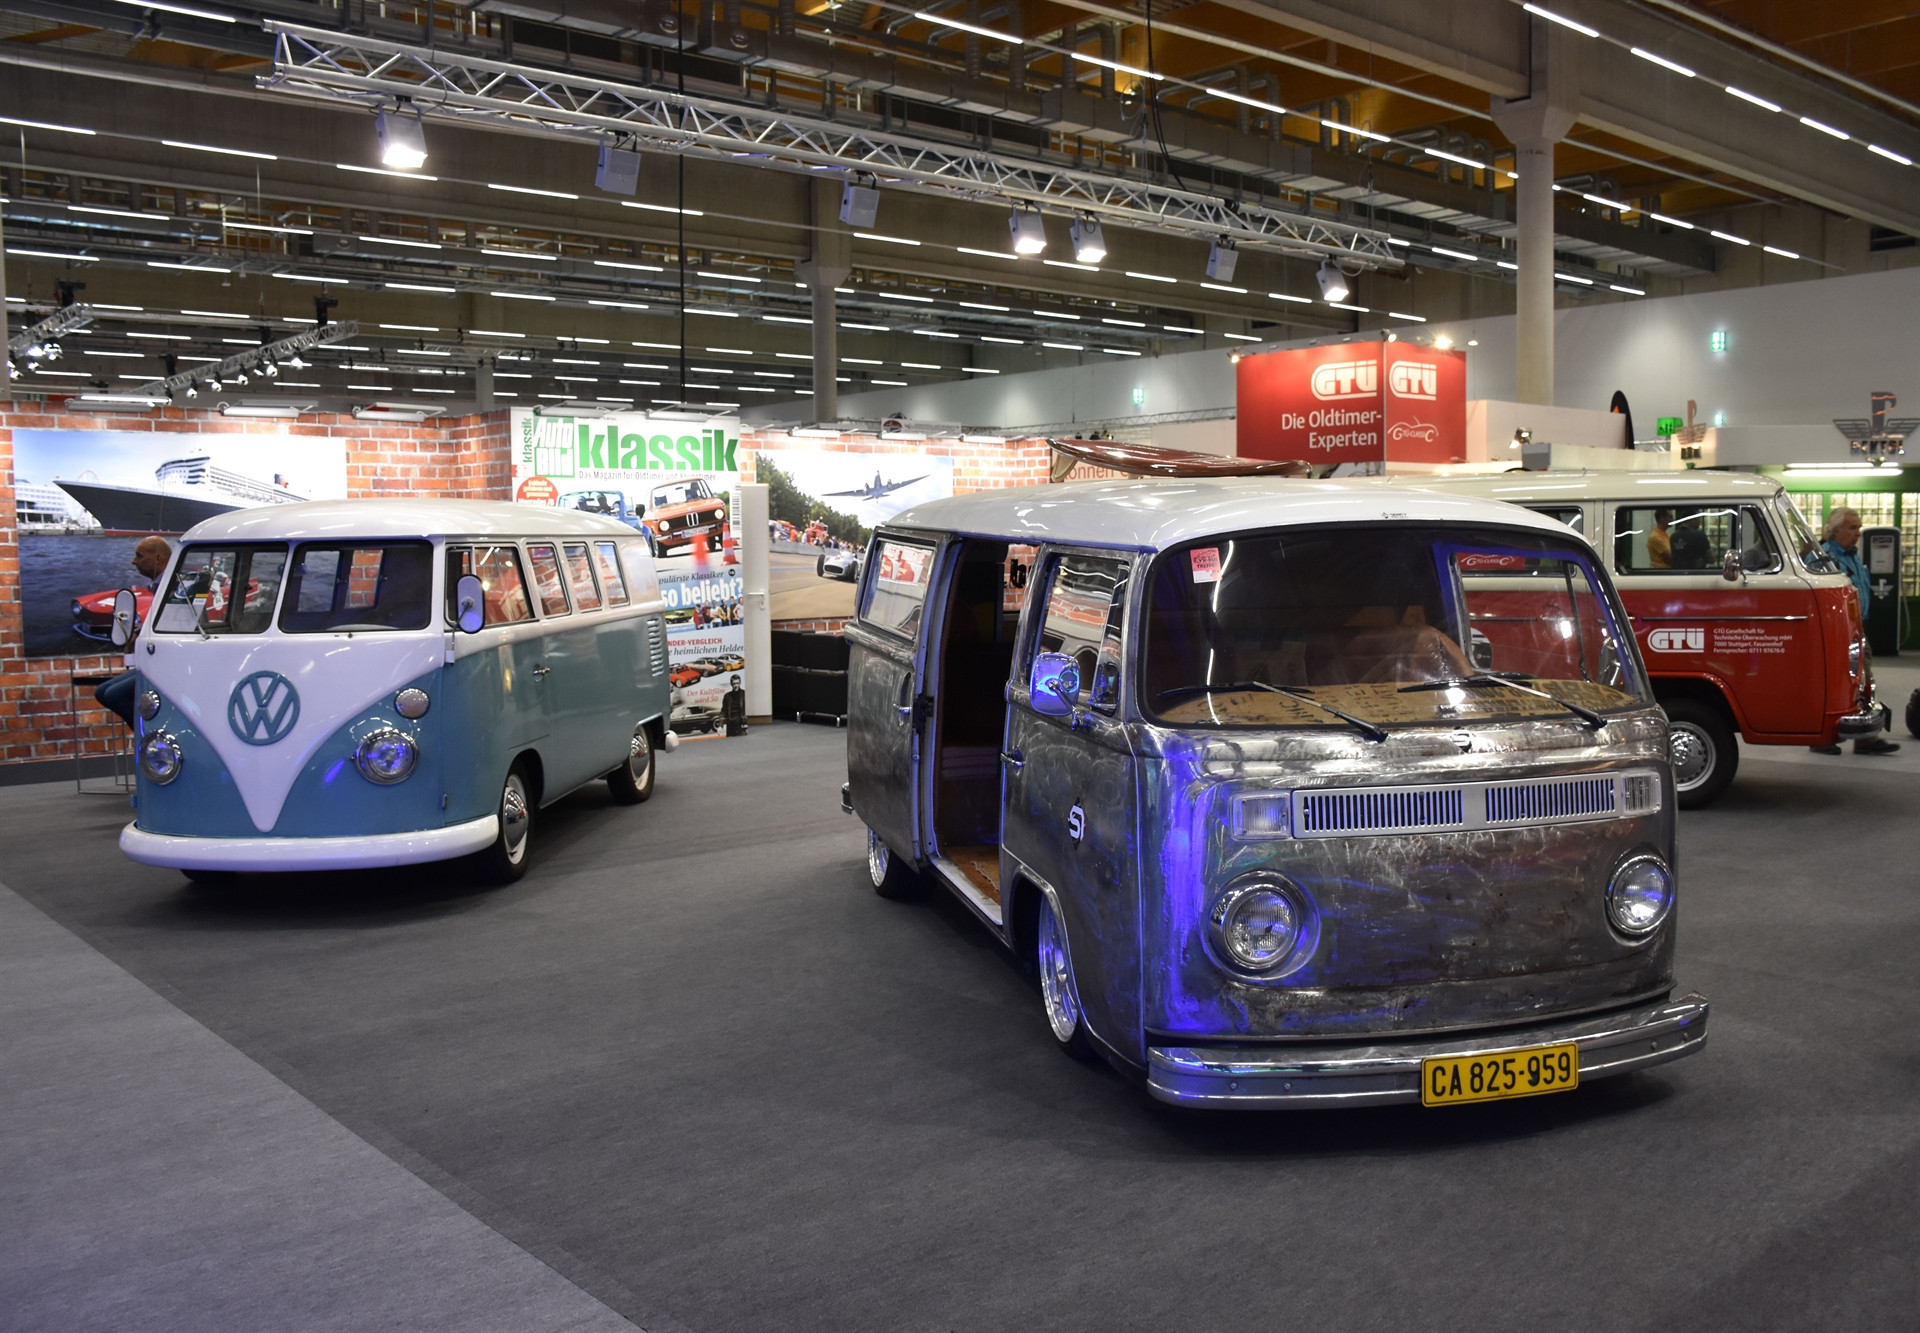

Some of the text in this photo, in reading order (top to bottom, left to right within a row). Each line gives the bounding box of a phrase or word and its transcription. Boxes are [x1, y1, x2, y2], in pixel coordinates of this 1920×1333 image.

[1311, 360, 1377, 401] GTÜ
[1389, 360, 1437, 401] GTÜ
[534, 417, 574, 448] Auto
[1282, 408, 1382, 430] Die Oldtimer-
[522, 418, 533, 463] klassik
[578, 424, 738, 472] klassik
[1309, 431, 1377, 452] Experten
[579, 471, 591, 479] Das
[594, 471, 622, 481] Magazin
[635, 472, 664, 480] Oldtimer
[1065, 465, 1115, 480] onnen
[691, 570, 725, 580] Klassiker
[681, 577, 743, 606] beliebt?
[674, 646, 717, 655] heimlichen
[1647, 628, 1704, 653] GTÜ
[228, 670, 300, 746] VW
[1432, 1052, 1570, 1097] CA 825-959
